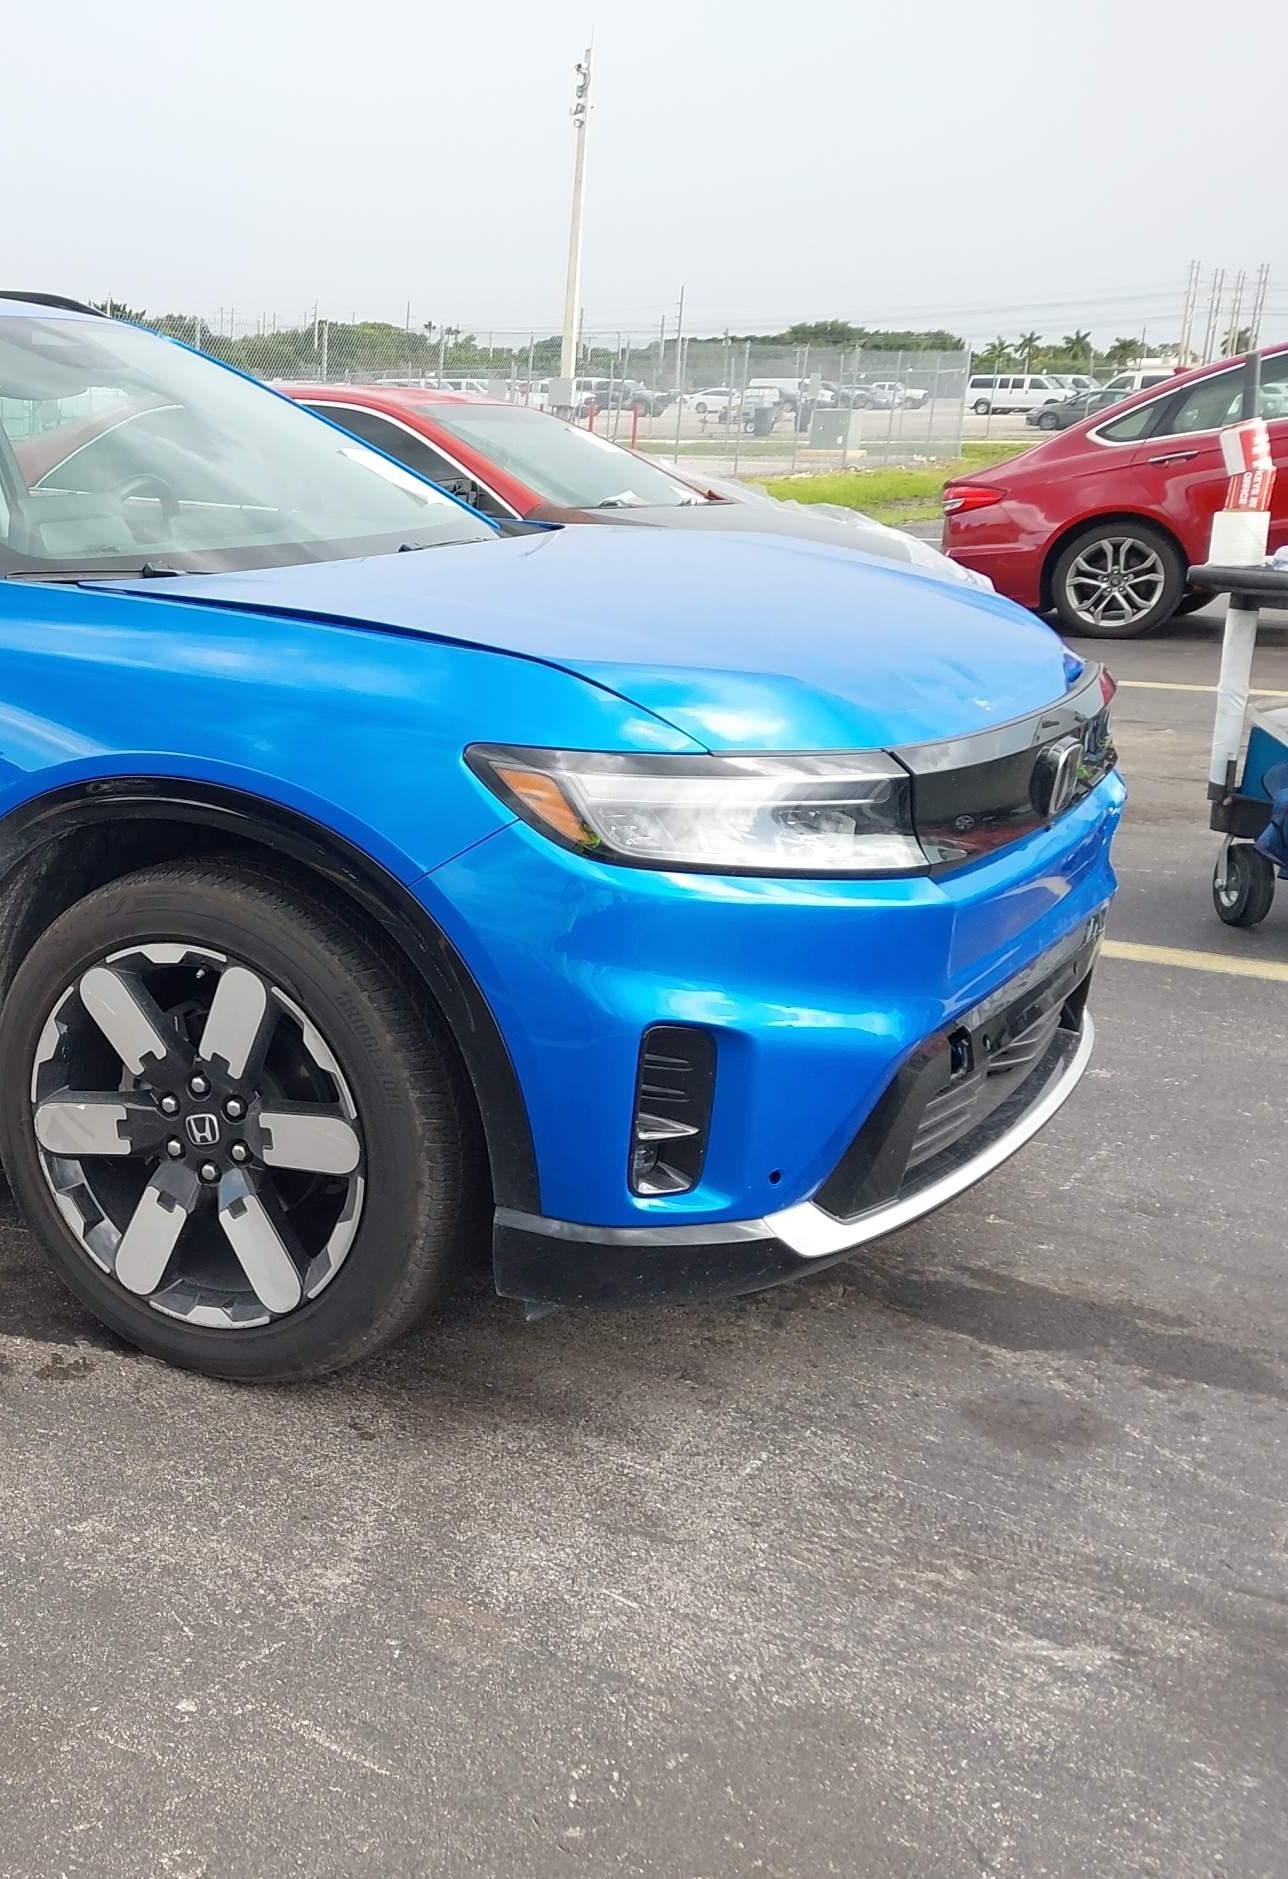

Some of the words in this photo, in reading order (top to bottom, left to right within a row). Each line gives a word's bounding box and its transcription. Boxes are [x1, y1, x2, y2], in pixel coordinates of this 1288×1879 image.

[1238, 471, 1253, 505] OFFICE
[1251, 470, 1263, 496] KEYS
[1248, 497, 1258, 508] IN
